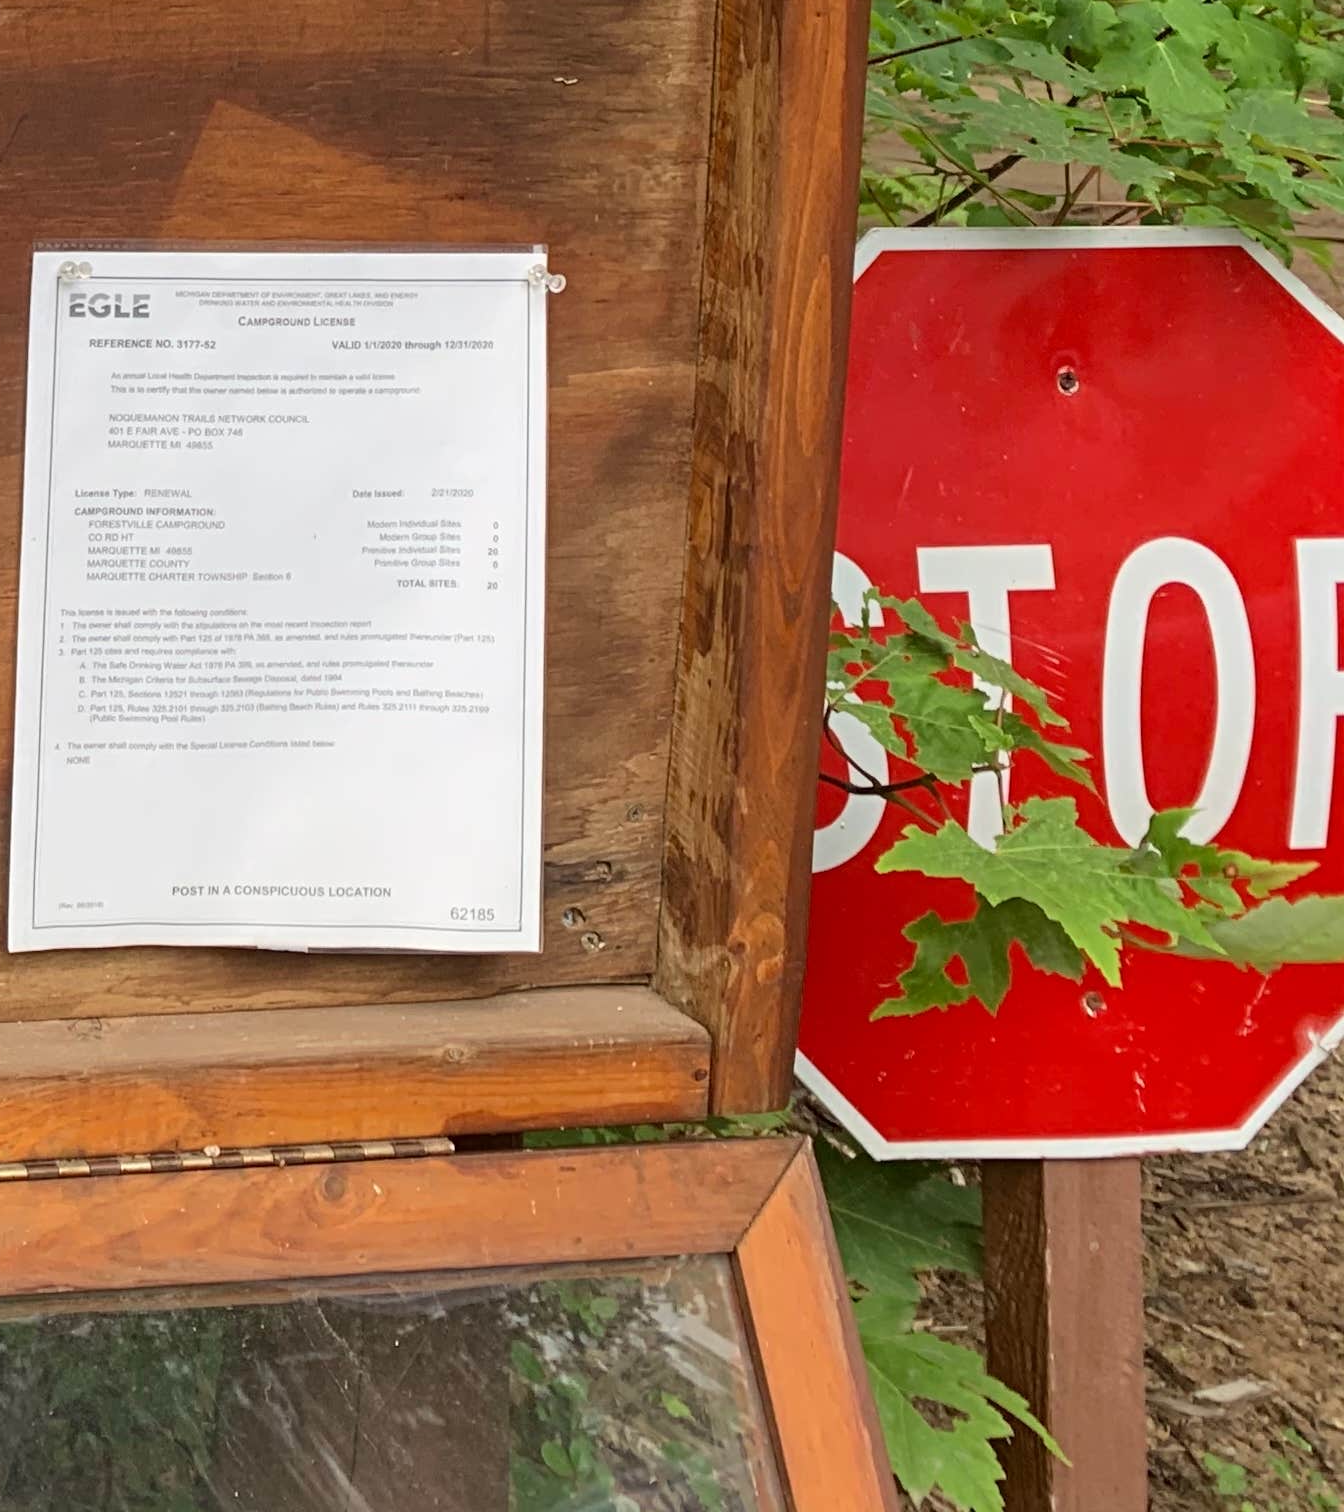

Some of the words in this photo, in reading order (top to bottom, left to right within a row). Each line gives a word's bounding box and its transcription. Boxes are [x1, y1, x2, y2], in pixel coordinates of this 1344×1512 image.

[68, 292, 151, 319] EGLE
[237, 315, 311, 328] CAMPGROUND
[313, 315, 356, 328] LICENSE
[88, 337, 153, 350] REFERENCE
[155, 338, 174, 350] NO.
[176, 338, 217, 350] 3177-52
[331, 340, 362, 352] VALID
[364, 340, 403, 351] 1/1/2020
[404, 340, 442, 353] through
[108, 412, 180, 424] NOQUEMANON
[181, 412, 216, 424] TRAILS
[217, 413, 267, 425] NETWORK
[267, 414, 310, 425] COUNCIL
[74, 488, 111, 499] License
[112, 487, 137, 501] Type:
[143, 487, 193, 499] RENEWAL
[88, 518, 154, 530] FORESTVILLE
[154, 518, 226, 531] CAMPGROUND
[171, 884, 205, 898] POST
[207, 884, 220, 897] IN
[222, 884, 231, 896] A
[233, 884, 325, 898] CONSPICUOUS
[328, 885, 392, 898] LOCATION
[449, 906, 495, 922] 62185
